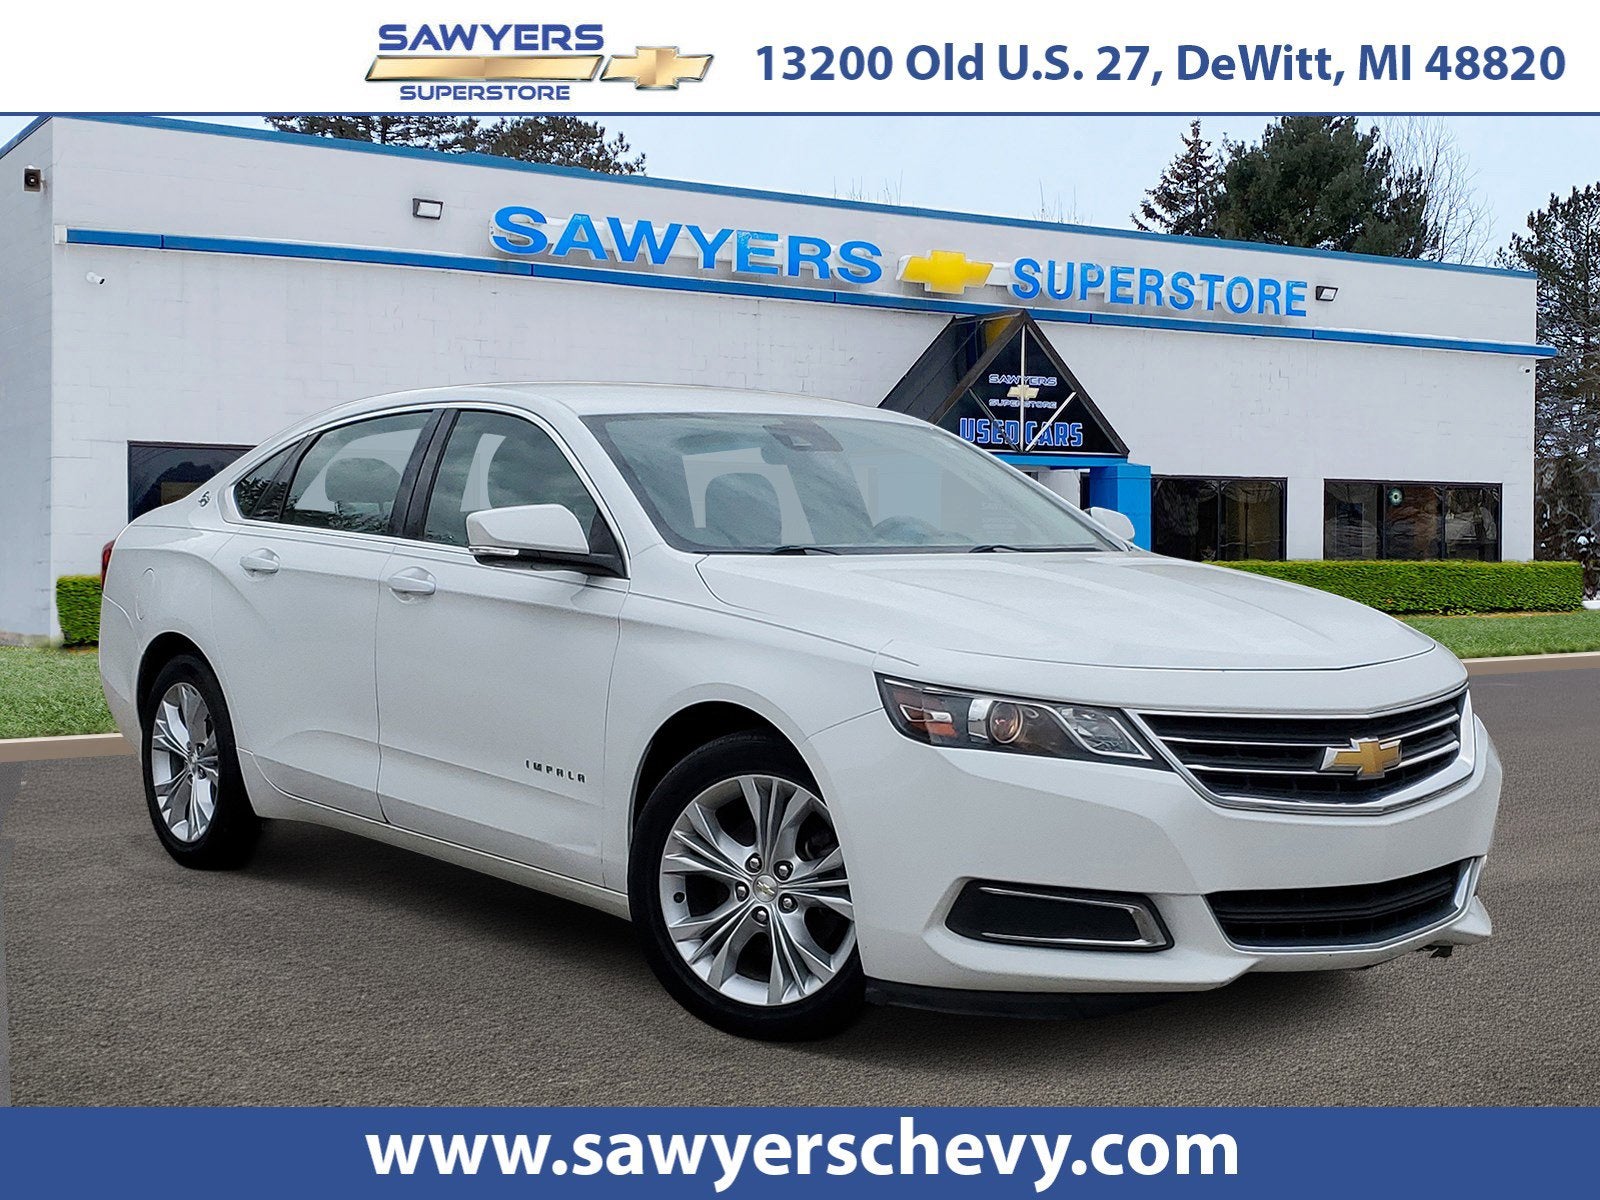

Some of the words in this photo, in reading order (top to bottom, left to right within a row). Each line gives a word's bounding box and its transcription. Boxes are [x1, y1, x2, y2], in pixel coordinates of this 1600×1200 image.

[490, 205, 883, 284] SAWYERS
[1010, 257, 1308, 317] SUPERSTORE
[988, 373, 1057, 387] SAWYERS
[988, 398, 1057, 409] SUPESTORE
[959, 417, 1020, 446] USED
[1025, 420, 1083, 447] CARS
[525, 759, 586, 783] IMPALA
